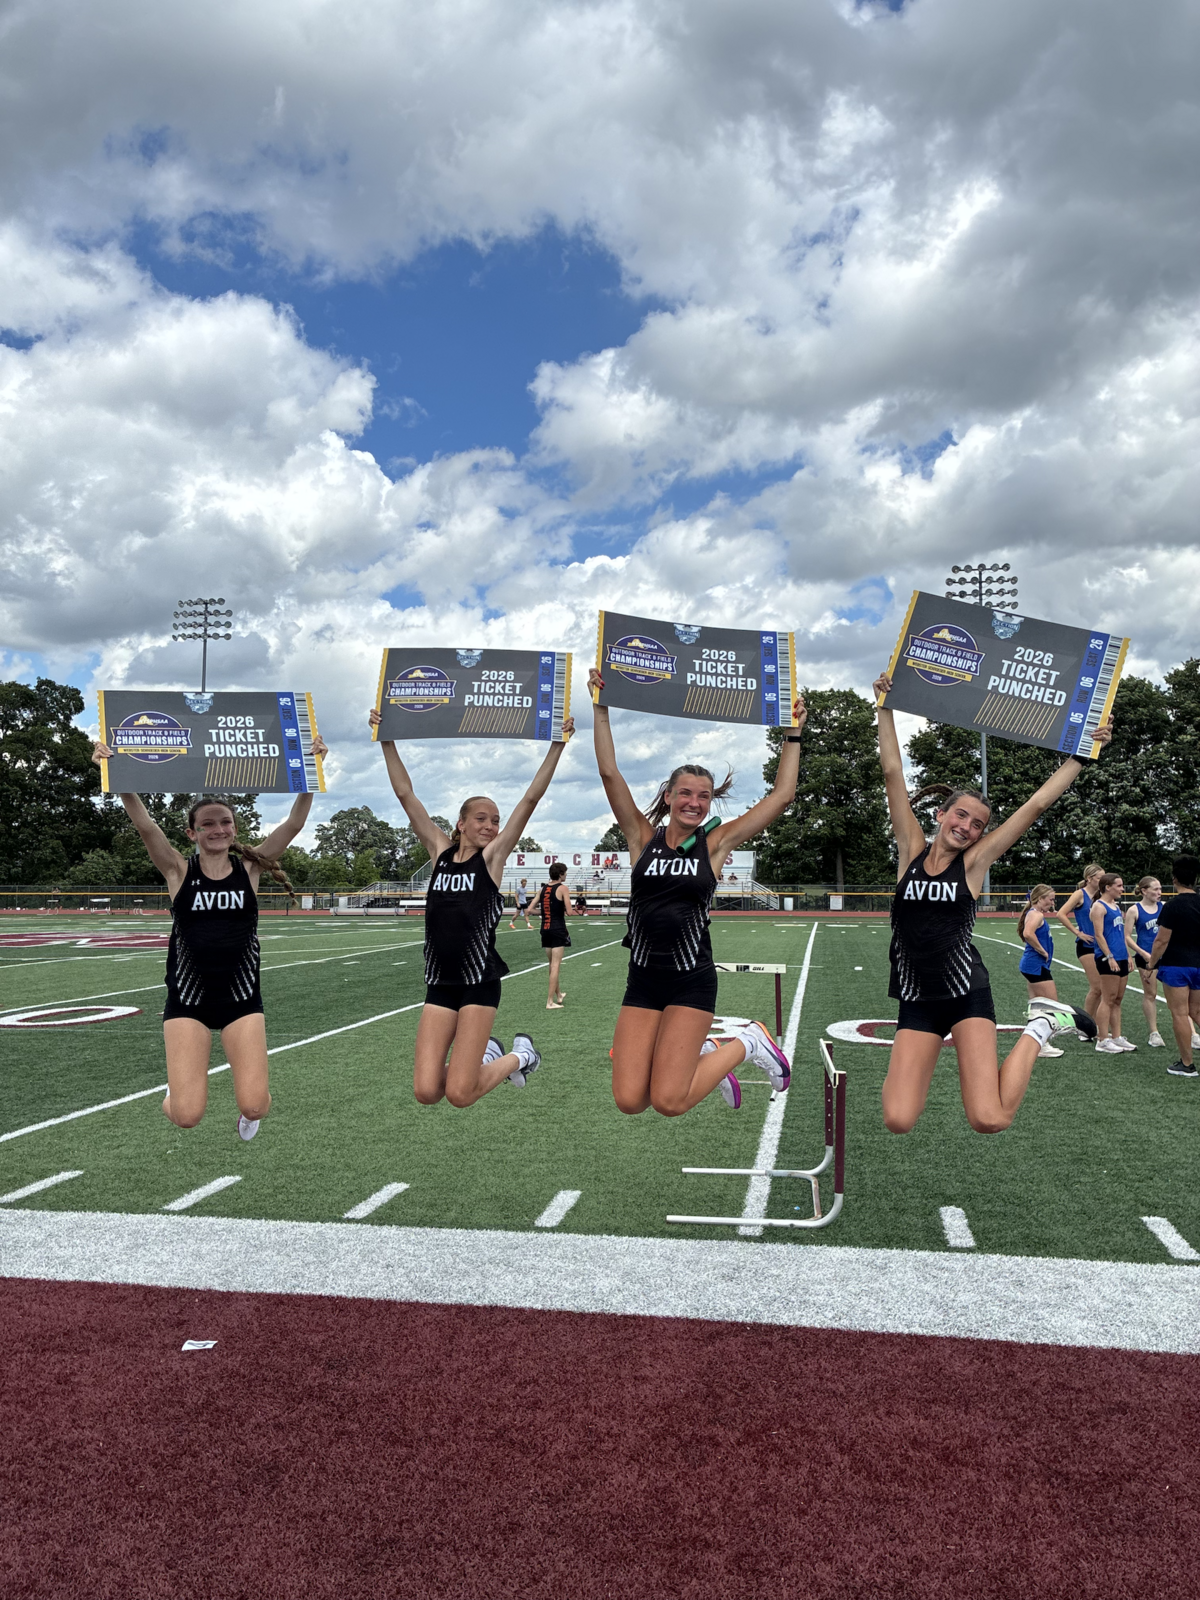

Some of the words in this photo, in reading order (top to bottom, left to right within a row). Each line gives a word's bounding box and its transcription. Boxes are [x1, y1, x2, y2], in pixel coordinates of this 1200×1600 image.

[914, 639, 939, 650] OUTDOOR
[940, 646, 957, 655] TRACK
[962, 652, 978, 660] FIELD
[1089, 638, 1104, 650] 26
[612, 648, 635, 656] OUTDOOR
[702, 649, 736, 661] 2026
[909, 646, 977, 672] CHAMPIONSHIPS
[1014, 646, 1054, 666] 2026
[610, 654, 672, 671] CHAMPIONSHIPS
[693, 659, 745, 675] TICKET
[764, 664, 776, 672] 06
[481, 670, 514, 681] 2026
[1001, 660, 1060, 686] TICKET
[472, 682, 523, 694] TICKET
[687, 673, 757, 690] PUNCHED
[1080, 676, 1094, 688] 06
[987, 676, 1067, 706] PUNCHED
[280, 697, 291, 706] 26
[464, 696, 532, 707] PUNCHED
[766, 704, 775, 725] SECTION
[1069, 712, 1084, 723] 05
[217, 716, 254, 728] 2026
[209, 729, 265, 742] TICKET
[285, 728, 297, 736] 06
[538, 720, 548, 739] SECTION
[116, 736, 187, 745] CHAMPIONSHIPS
[1062, 725, 1078, 751] SECTION
[204, 744, 279, 757] PUNCHED
[289, 758, 301, 767] 05
[293, 769, 302, 792] SECTION
[544, 856, 558, 865] OF
[644, 858, 700, 877] AVON
[432, 873, 476, 892] AVON
[904, 880, 958, 902] AVON
[191, 890, 245, 911] AVON
[543, 886, 552, 930] KNIGHTS
